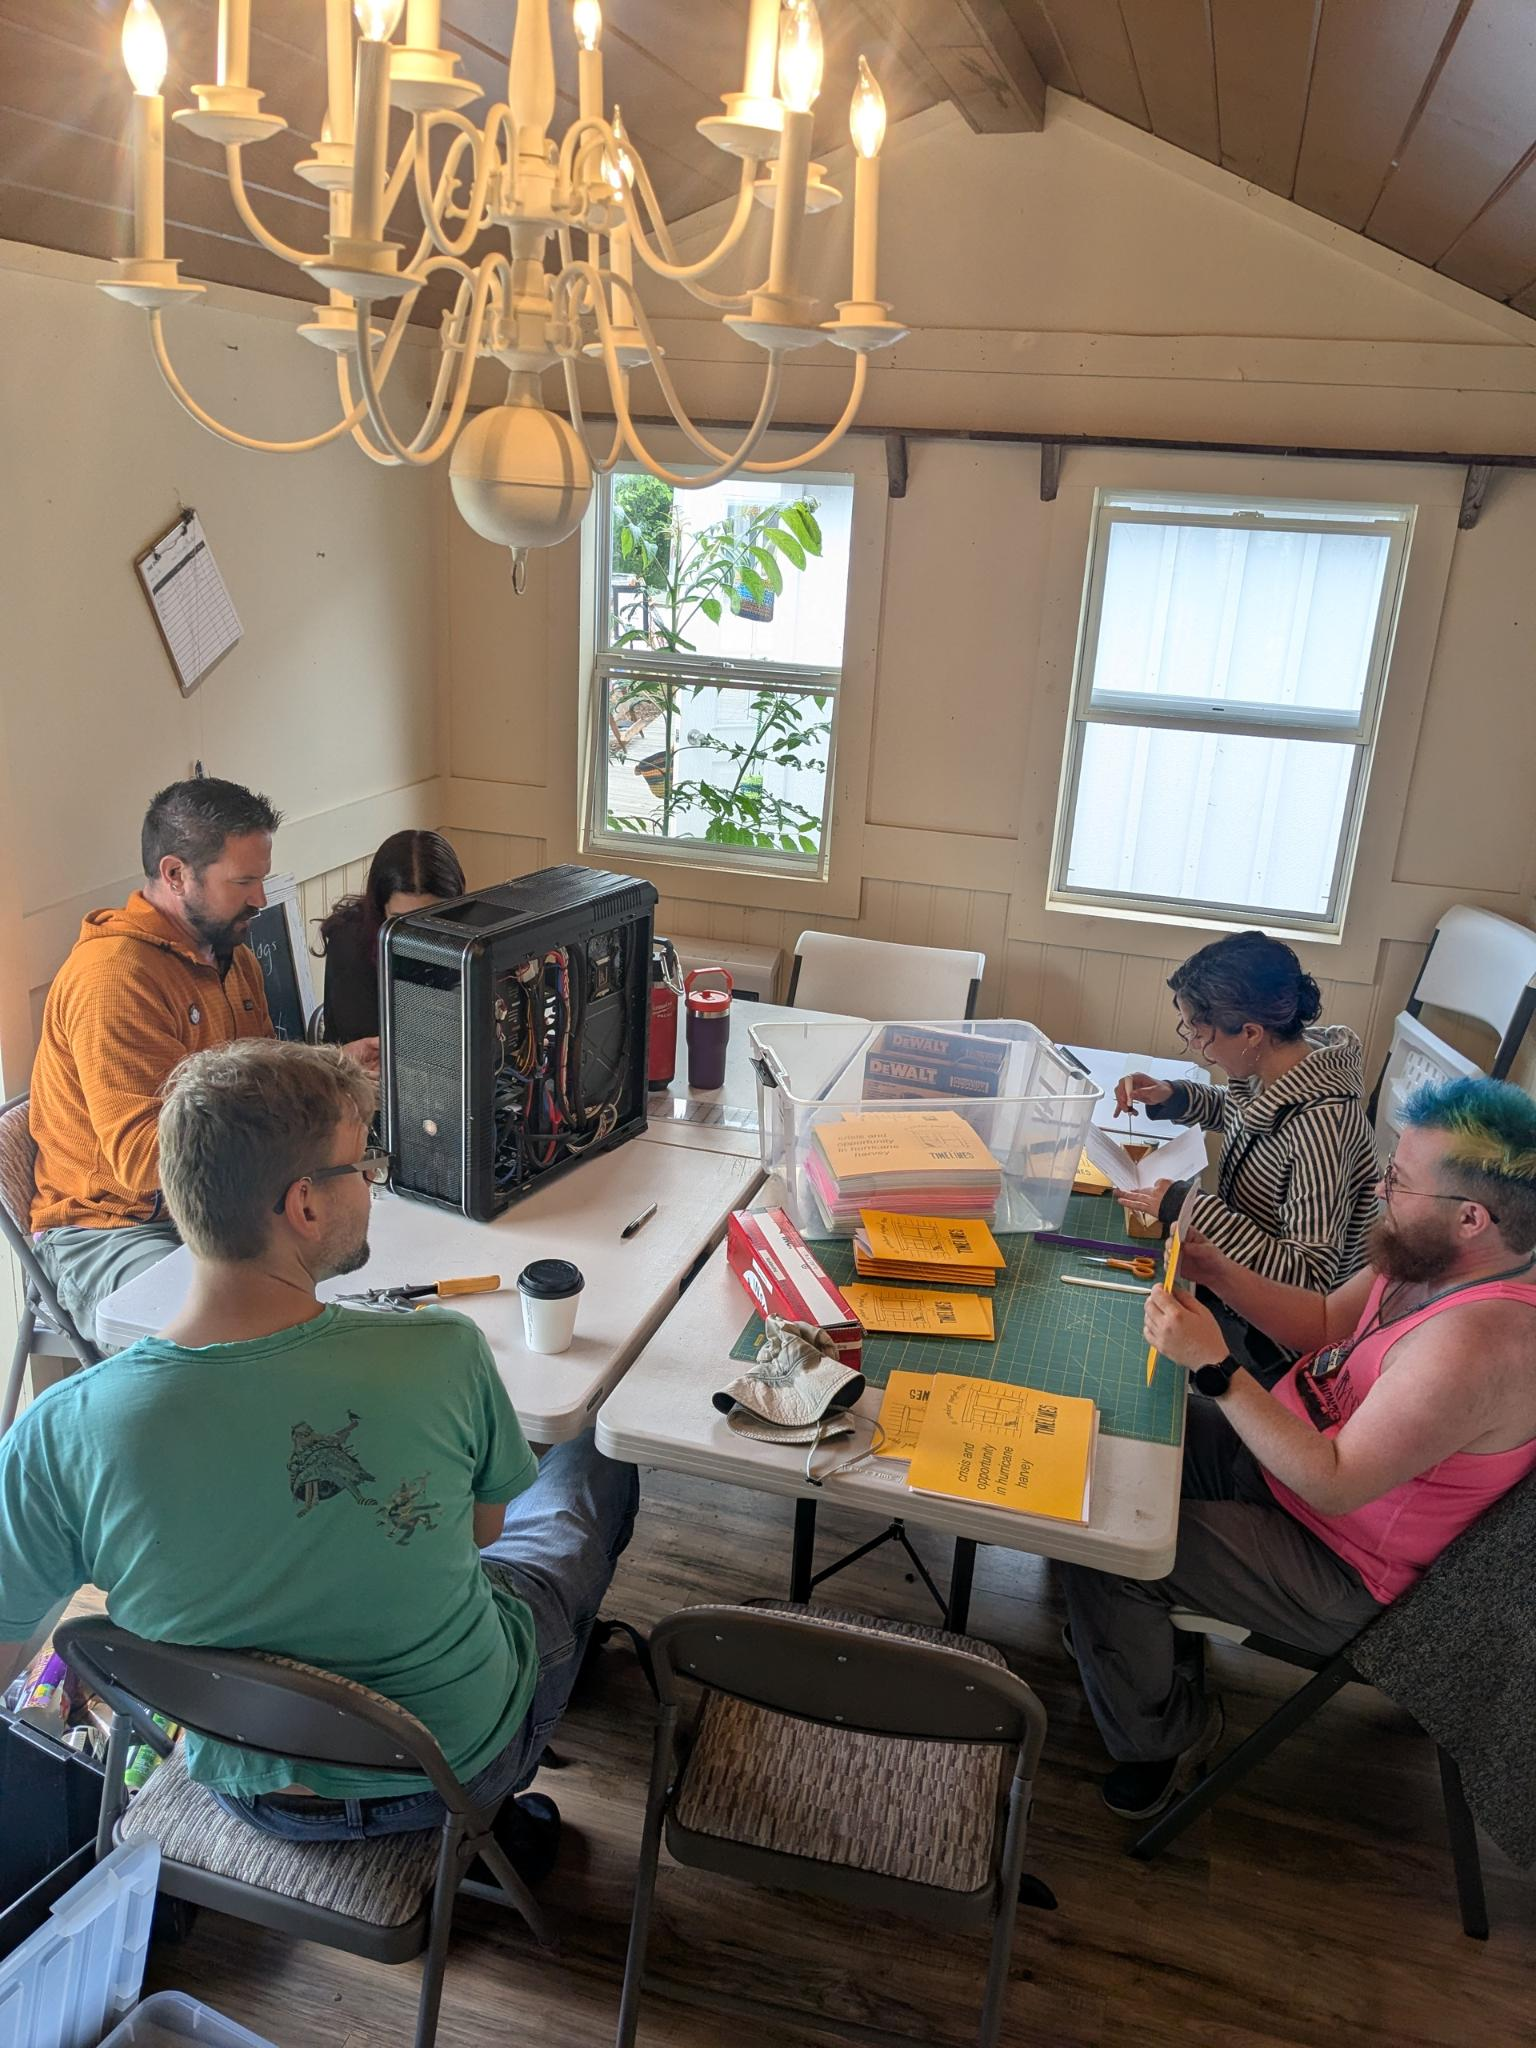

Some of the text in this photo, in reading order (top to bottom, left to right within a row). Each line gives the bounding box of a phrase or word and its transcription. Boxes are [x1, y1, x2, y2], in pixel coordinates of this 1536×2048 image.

[893, 1034, 949, 1052] DEWALT
[870, 1060, 938, 1084] DEWALT
[1034, 1404, 1058, 1435] TIMELINES
[958, 1442, 975, 1483] crisis and
[977, 1443, 997, 1491] opportunity
[993, 1446, 1014, 1496] in hurricane
[1015, 1459, 1034, 1489] harvey
